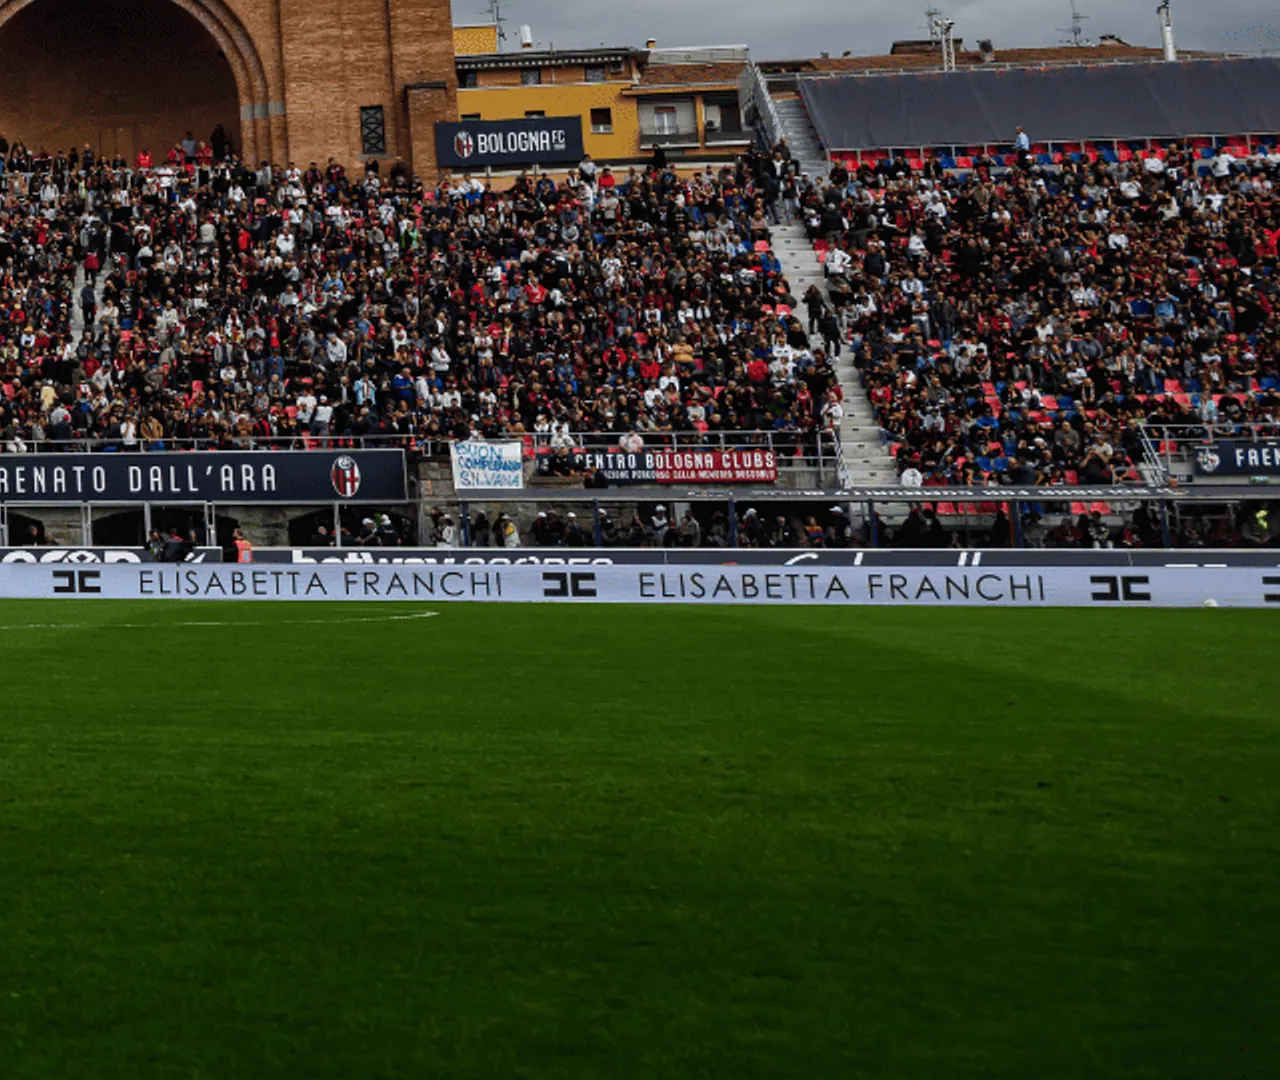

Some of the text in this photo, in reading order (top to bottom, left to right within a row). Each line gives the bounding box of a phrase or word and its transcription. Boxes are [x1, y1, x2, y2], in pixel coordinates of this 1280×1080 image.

[477, 130, 551, 154] BOLOGNA
[645, 452, 714, 469] BOLOGNA
[721, 451, 775, 469] CLUBS
[128, 463, 277, 493] DALL'ARA
[139, 569, 503, 597] ELISABETTA FRANCHI
[639, 572, 1046, 601] ELISABETTA FRANCHI
